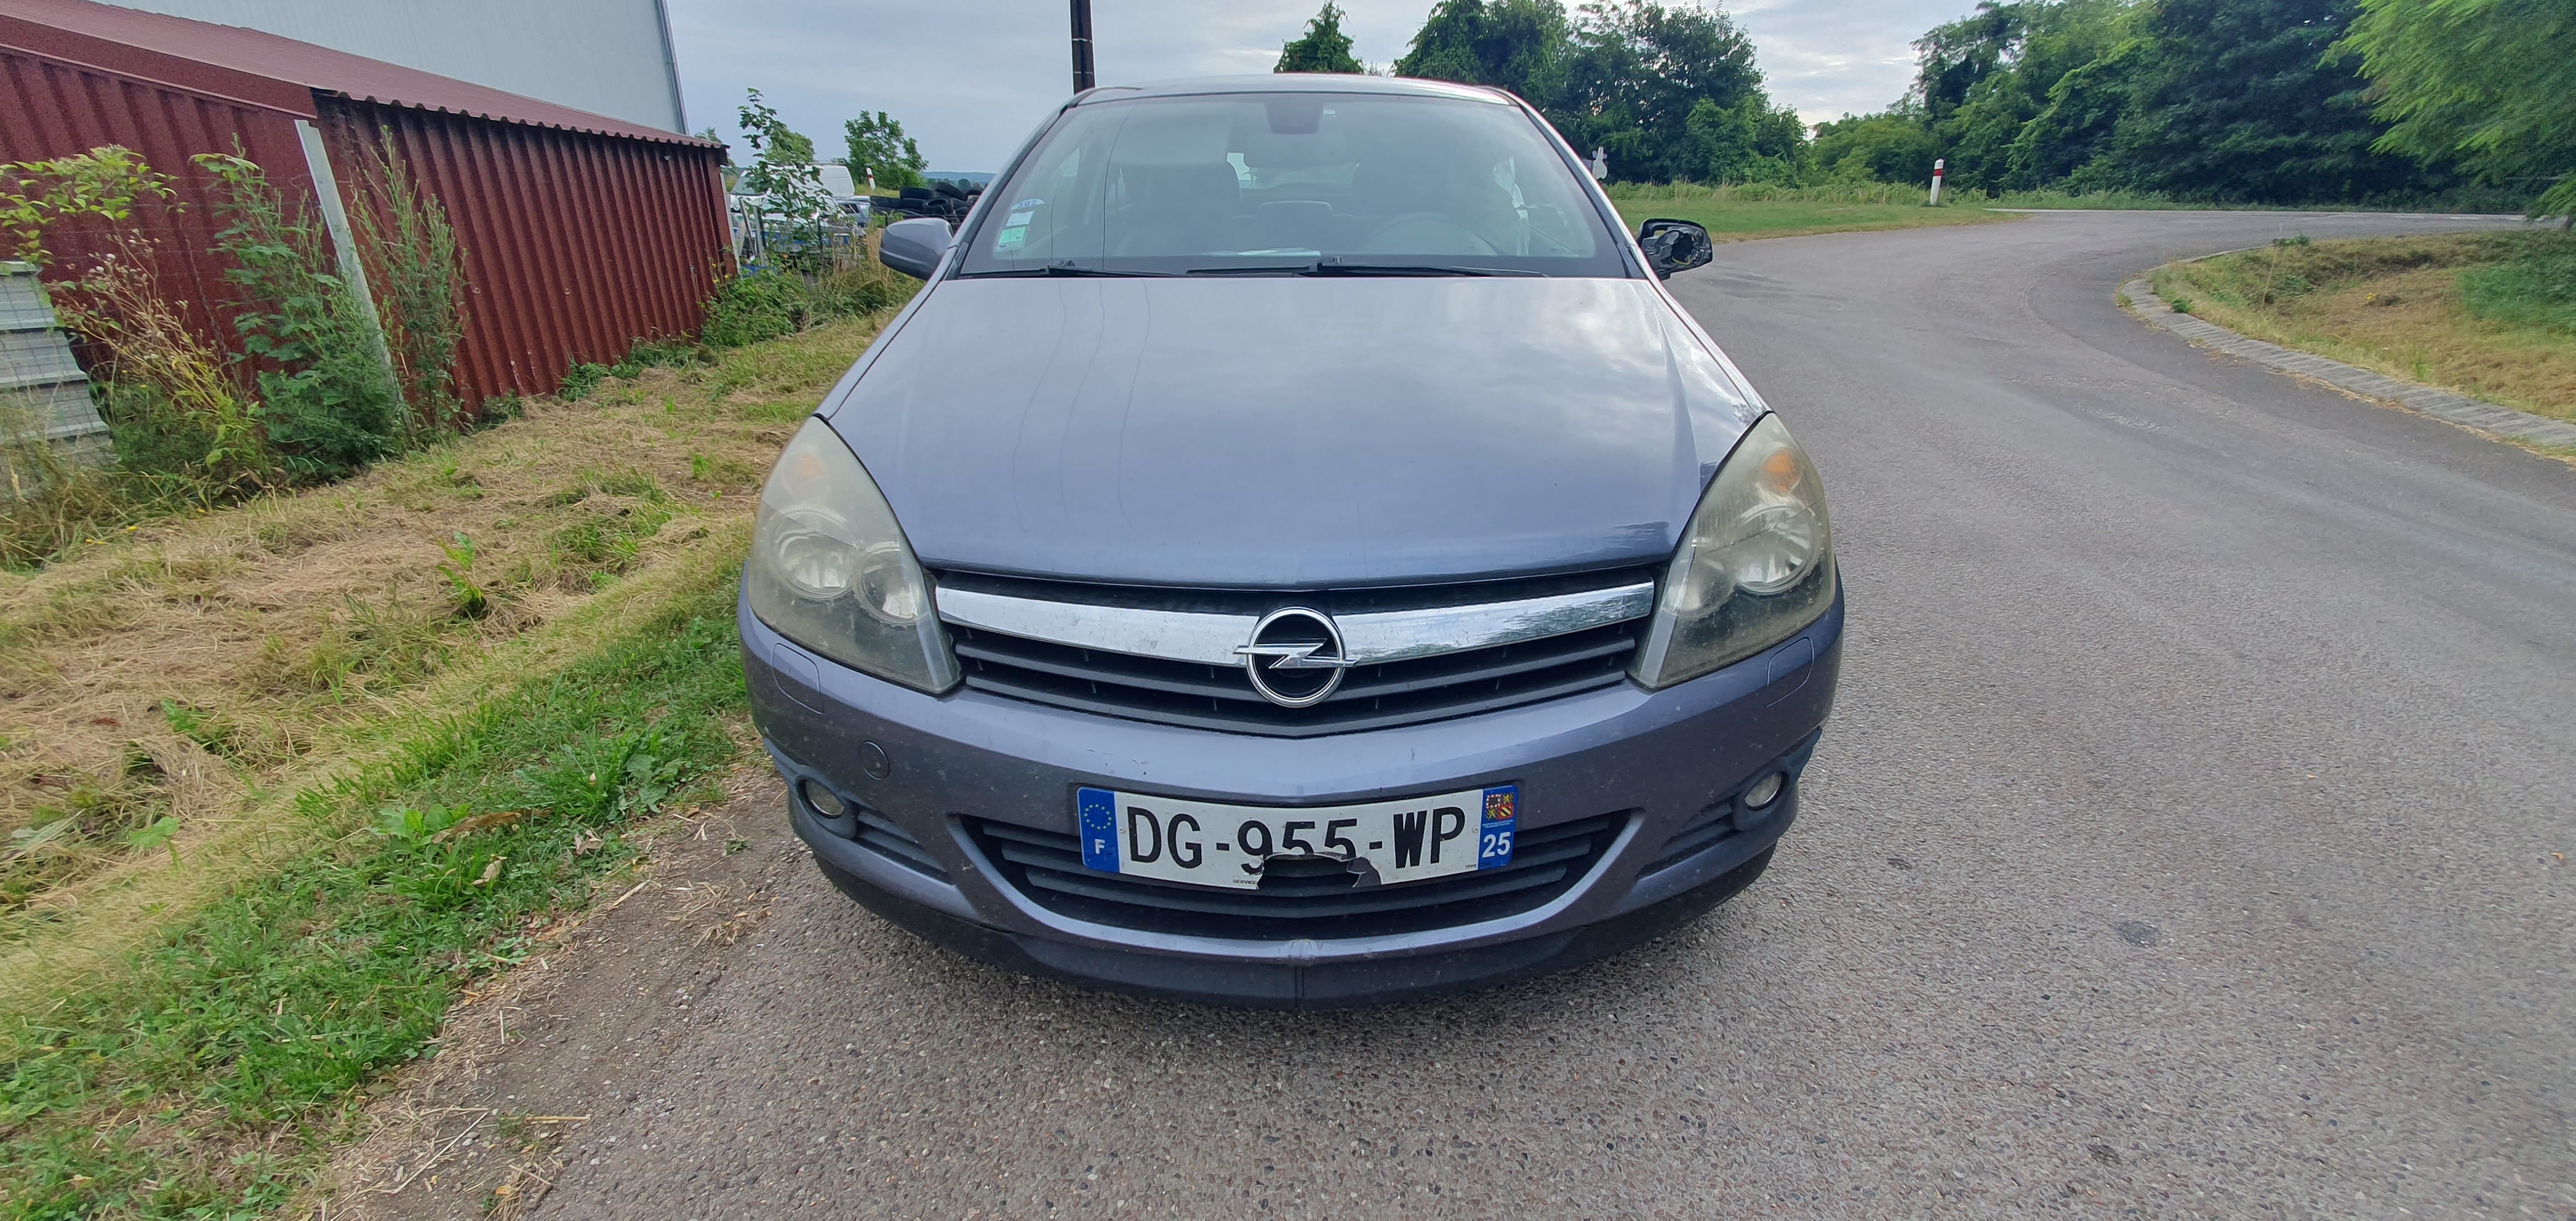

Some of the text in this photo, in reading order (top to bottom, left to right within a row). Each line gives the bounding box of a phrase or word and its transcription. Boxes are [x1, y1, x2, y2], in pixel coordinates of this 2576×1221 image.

[1095, 839, 1106, 854] F
[1127, 806, 1465, 875] DG-955-WP
[1482, 831, 1511, 858] 25
